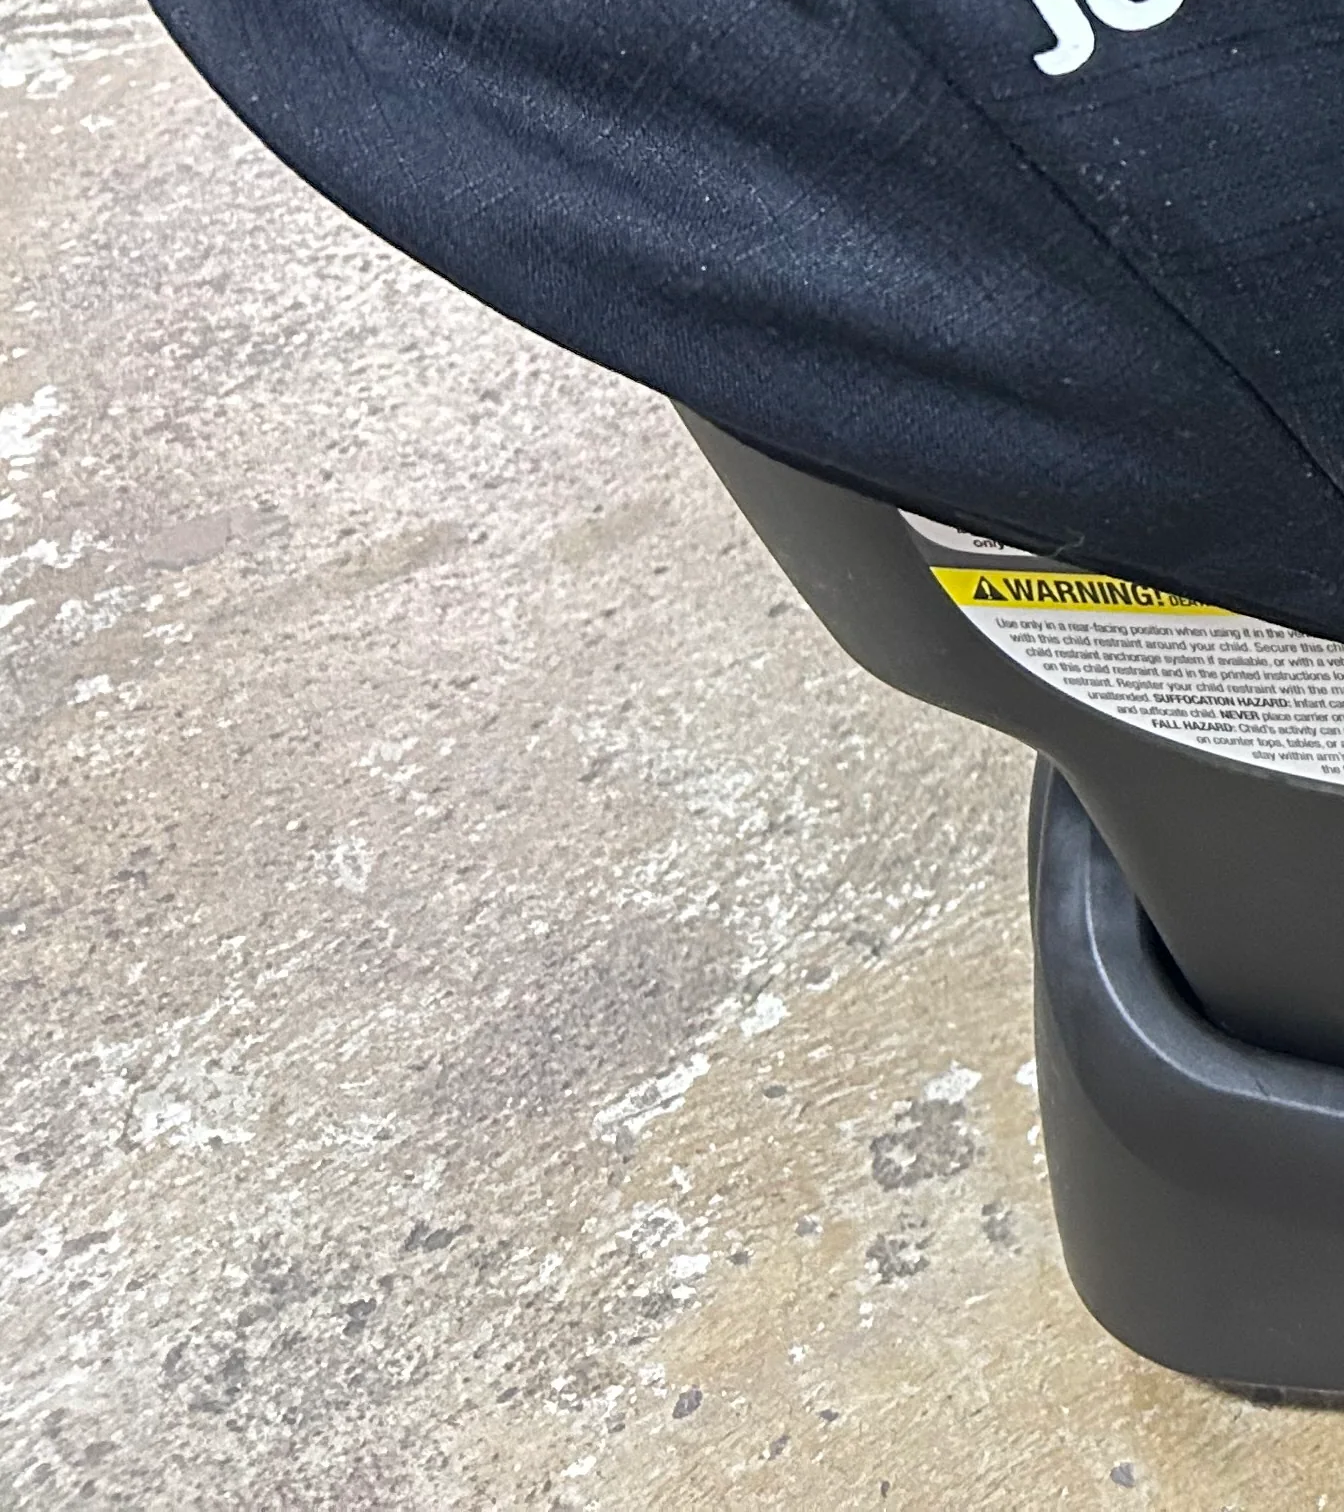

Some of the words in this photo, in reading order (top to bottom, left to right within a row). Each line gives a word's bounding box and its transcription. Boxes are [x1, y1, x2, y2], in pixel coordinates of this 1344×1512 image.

[1002, 577, 1165, 607] WARNING!
[996, 617, 1018, 629] Use
[1020, 620, 1042, 632] only
[1045, 620, 1056, 630] in
[1059, 623, 1066, 631] a
[1068, 622, 1128, 636] rear-facing
[1130, 624, 1172, 636] position
[1175, 626, 1207, 637] when
[1209, 628, 1241, 639] using
[1243, 627, 1250, 637] it
[1253, 628, 1264, 638] in
[1267, 628, 1285, 638] the
[1010, 633, 1036, 643] with
[1038, 634, 1060, 645] this
[1062, 635, 1091, 646] child
[1094, 637, 1142, 649] restraint
[1146, 640, 1187, 651] around
[1190, 643, 1215, 653] your
[1254, 642, 1297, 653] Secure
[1301, 643, 1323, 653] this
[1026, 647, 1053, 657] child
[1055, 649, 1100, 660] restraint
[1102, 651, 1162, 664] anchorage
[1164, 653, 1205, 665] system
[1207, 655, 1214, 665] if
[1274, 658, 1285, 667] or
[1288, 657, 1314, 667] with
[1317, 657, 1325, 667] a
[1043, 662, 1058, 671] on
[1060, 662, 1081, 673] this
[1083, 663, 1110, 674] child
[1113, 665, 1159, 677] restraint
[1161, 667, 1183, 678] and
[1185, 667, 1196, 678] in
[1198, 668, 1218, 679] the
[1220, 668, 1261, 681] printed
[1263, 670, 1331, 681] instructions
[1116, 678, 1164, 691] Register
[1166, 683, 1192, 693] your
[1196, 682, 1223, 693] child
[1226, 683, 1276, 694] restraint
[1279, 684, 1306, 694] with
[1308, 684, 1328, 695] the
[1153, 693, 1235, 706] SUFFOCATION
[1237, 696, 1292, 708] HAZARD:
[1294, 697, 1326, 708] Infant
[1117, 704, 1138, 714] and
[1140, 706, 1188, 717] suffocate
[1219, 709, 1260, 721] NEVER
[1262, 712, 1291, 722] place
[1294, 712, 1329, 722] carrier
[1151, 719, 1182, 729] FALL
[1183, 721, 1237, 732] HAZARD:
[1239, 723, 1277, 735] Child's
[1278, 724, 1317, 736] activity
[1320, 726, 1341, 735] can
[1196, 735, 1211, 744] on
[1213, 736, 1254, 747] counter
[1326, 740, 1337, 748] or
[1252, 750, 1275, 761] stay
[1278, 751, 1314, 761] within
[1321, 764, 1340, 774] the
